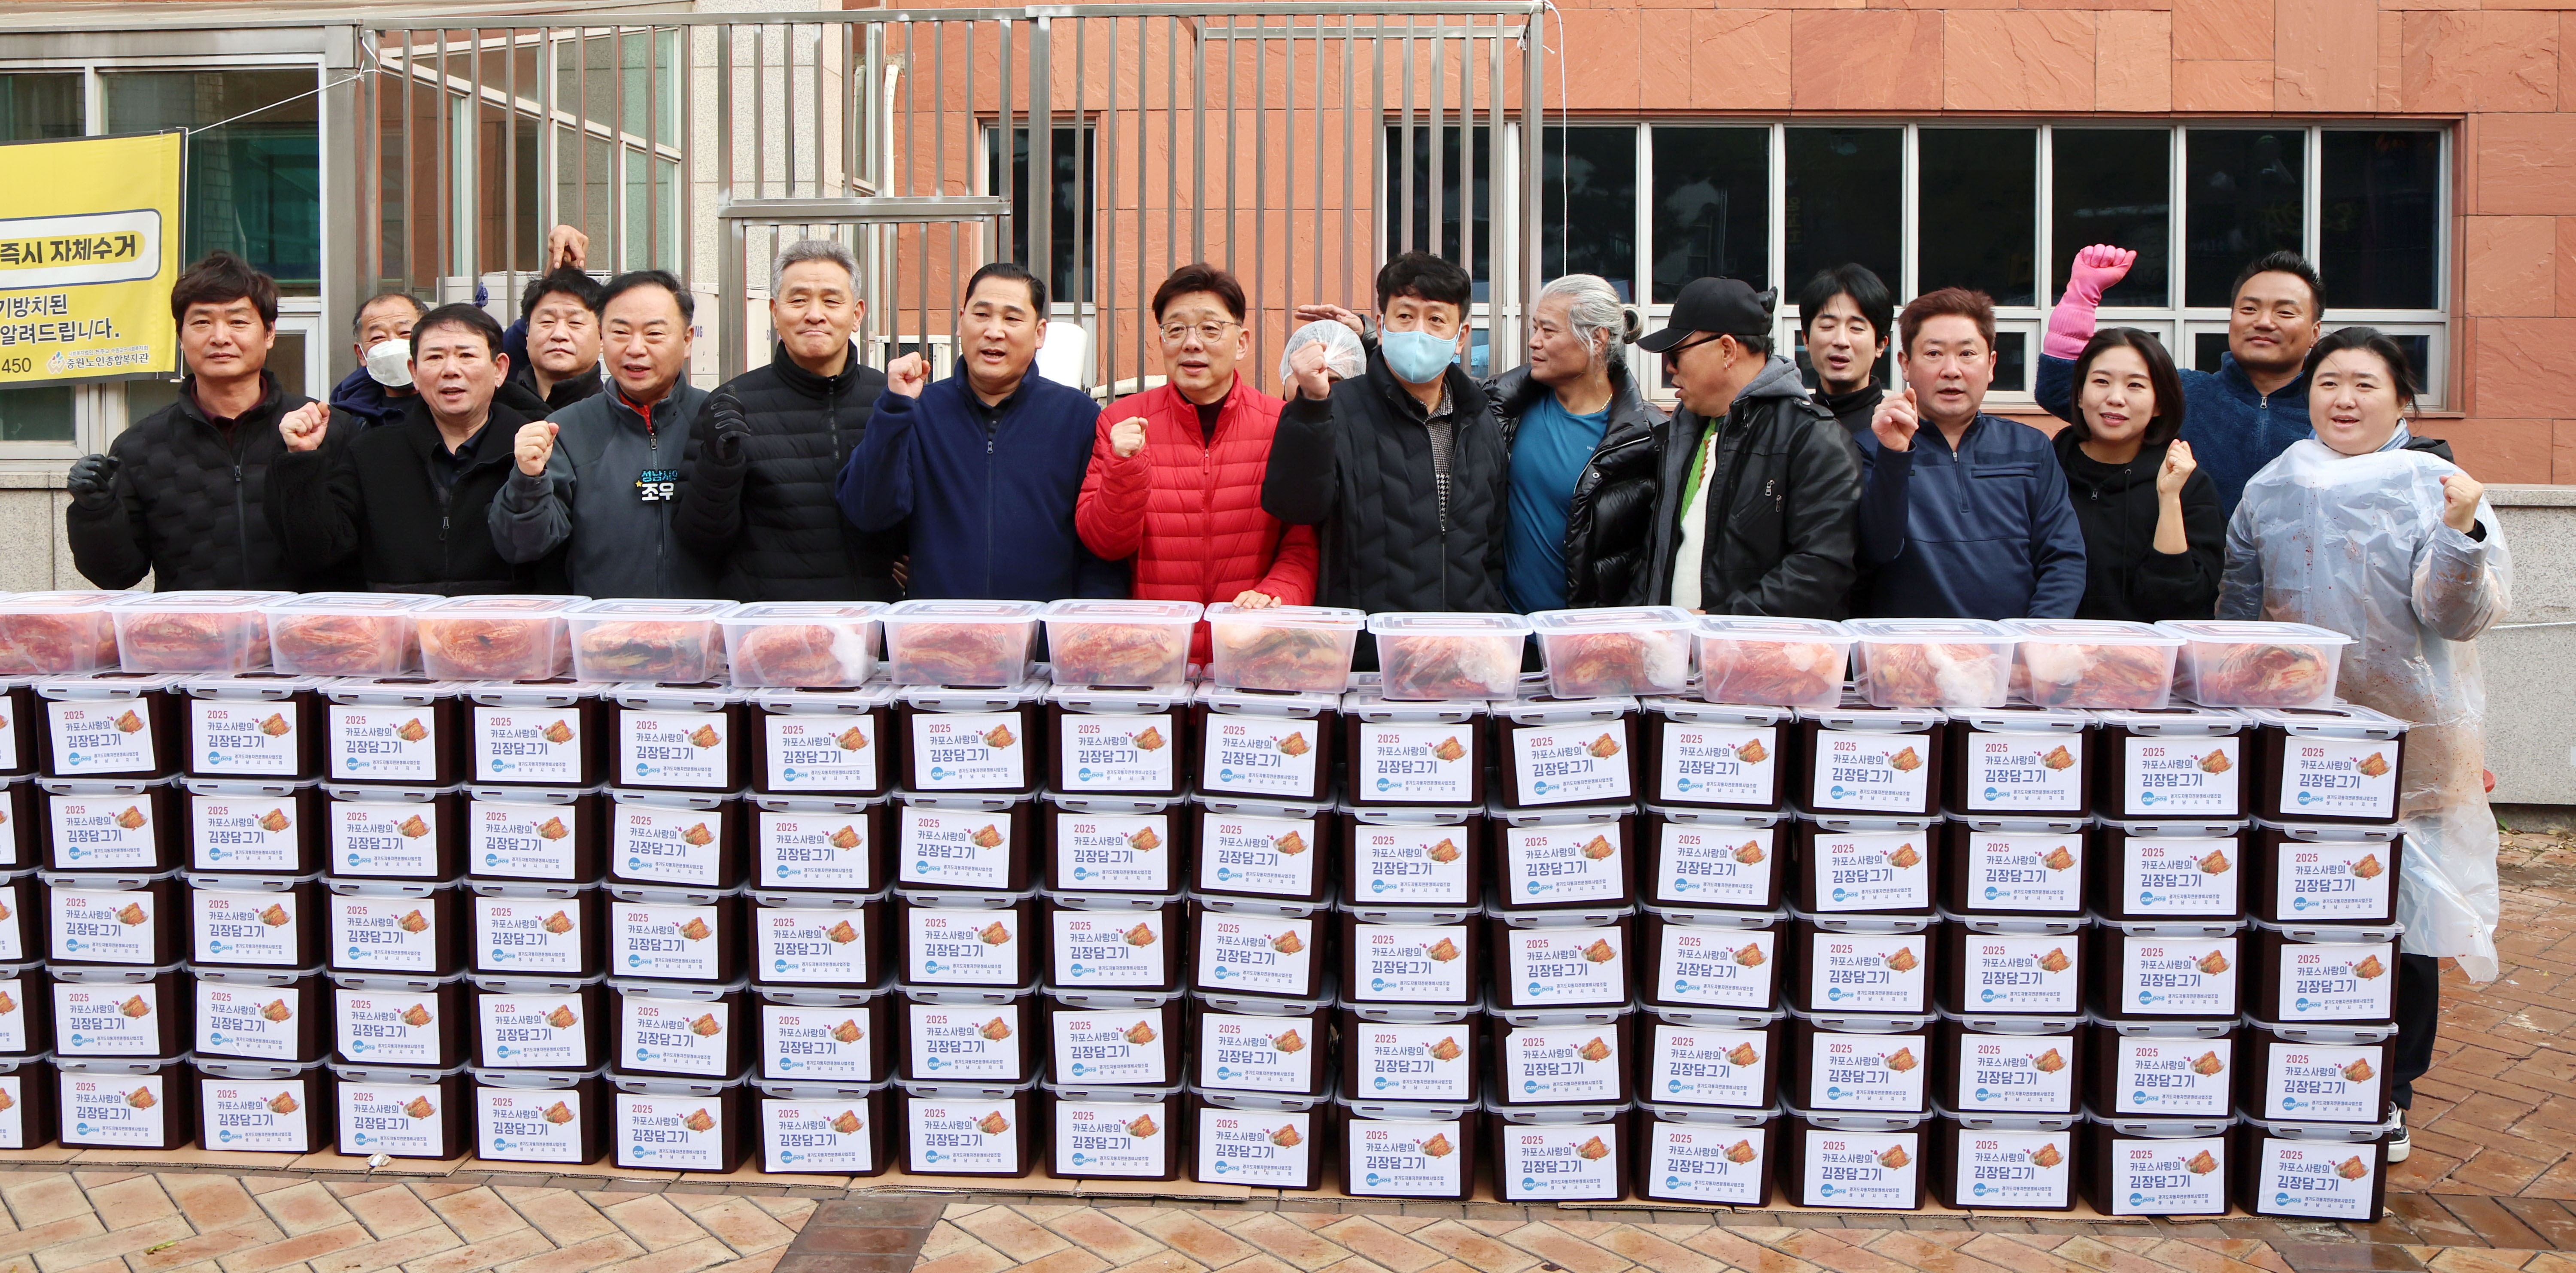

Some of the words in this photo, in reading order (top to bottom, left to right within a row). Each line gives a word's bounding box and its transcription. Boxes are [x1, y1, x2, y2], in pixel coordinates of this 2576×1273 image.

[0, 241, 43, 264] 즉시
[50, 235, 135, 261] 자체수거
[0, 318, 119, 345] 알려드립니다.
[2, 358, 31, 373] 450
[67, 353, 149, 369] 중원노인종합복지관
[64, 711, 85, 720] 2025
[490, 717, 511, 726] 2025
[929, 724, 951, 733] 2025
[66, 733, 121, 748] 김장담그기
[1378, 734, 1400, 743] 2025
[490, 742, 548, 756] 김장담그기
[1834, 741, 1856, 751] 2025
[2302, 747, 2324, 757] 2025
[930, 748, 989, 763] 김장담그기
[1376, 760, 1437, 774] 김장담그기
[1832, 768, 1893, 784] 김장담그기
[2299, 773, 2360, 789] 김장담그기
[346, 812, 367, 821] 2025
[776, 823, 797, 832] 2025
[1220, 824, 1242, 835] 2025
[346, 837, 403, 850] 김장담그기
[1678, 835, 1701, 845] 2025
[776, 848, 835, 862] 김장담그기
[1218, 850, 1278, 866] 김장담그기
[2142, 848, 2164, 857] 2025
[1676, 860, 1736, 877] 김장담그기
[2141, 874, 2202, 887] 김장담그기
[209, 899, 229, 909] 2025
[628, 913, 648, 922] 2025
[209, 924, 264, 938] 김장담그기
[1069, 921, 1091, 930] 2025
[628, 938, 684, 952] 김장담그기
[1526, 939, 1549, 948] 2025
[1070, 946, 1129, 960] 김장담그기
[1983, 946, 2005, 955] 2025
[1527, 963, 1588, 978] 김장담그기
[1982, 972, 2042, 985] 김장담그기
[69, 993, 89, 1002] 2025
[494, 1004, 515, 1013] 2025
[70, 1018, 125, 1030] 김장담그기
[926, 1015, 947, 1024] 2025
[495, 1028, 552, 1042] 김장담그기
[1375, 1034, 1396, 1043] 2025
[926, 1040, 985, 1053] 김장담그기
[1830, 1043, 1852, 1053] 2025
[2286, 1054, 2309, 1064] 2025
[1374, 1060, 1434, 1073] 김장담그기
[1828, 1069, 1889, 1084] 김장담그기
[2284, 1080, 2345, 1094] 김장담그기
[353, 1092, 373, 1101] 2025
[778, 1109, 799, 1118] 2025
[353, 1117, 409, 1130] 김장담그기
[1216, 1119, 1238, 1129] 2025
[779, 1133, 837, 1147] 김장담그기
[1670, 1133, 1692, 1143] 2025
[1215, 1144, 1274, 1159] 김장담그기
[2130, 1150, 2152, 1159] 2025
[1668, 1159, 1728, 1175] 김장담그기
[2129, 1175, 2190, 1189] 김장담그기
